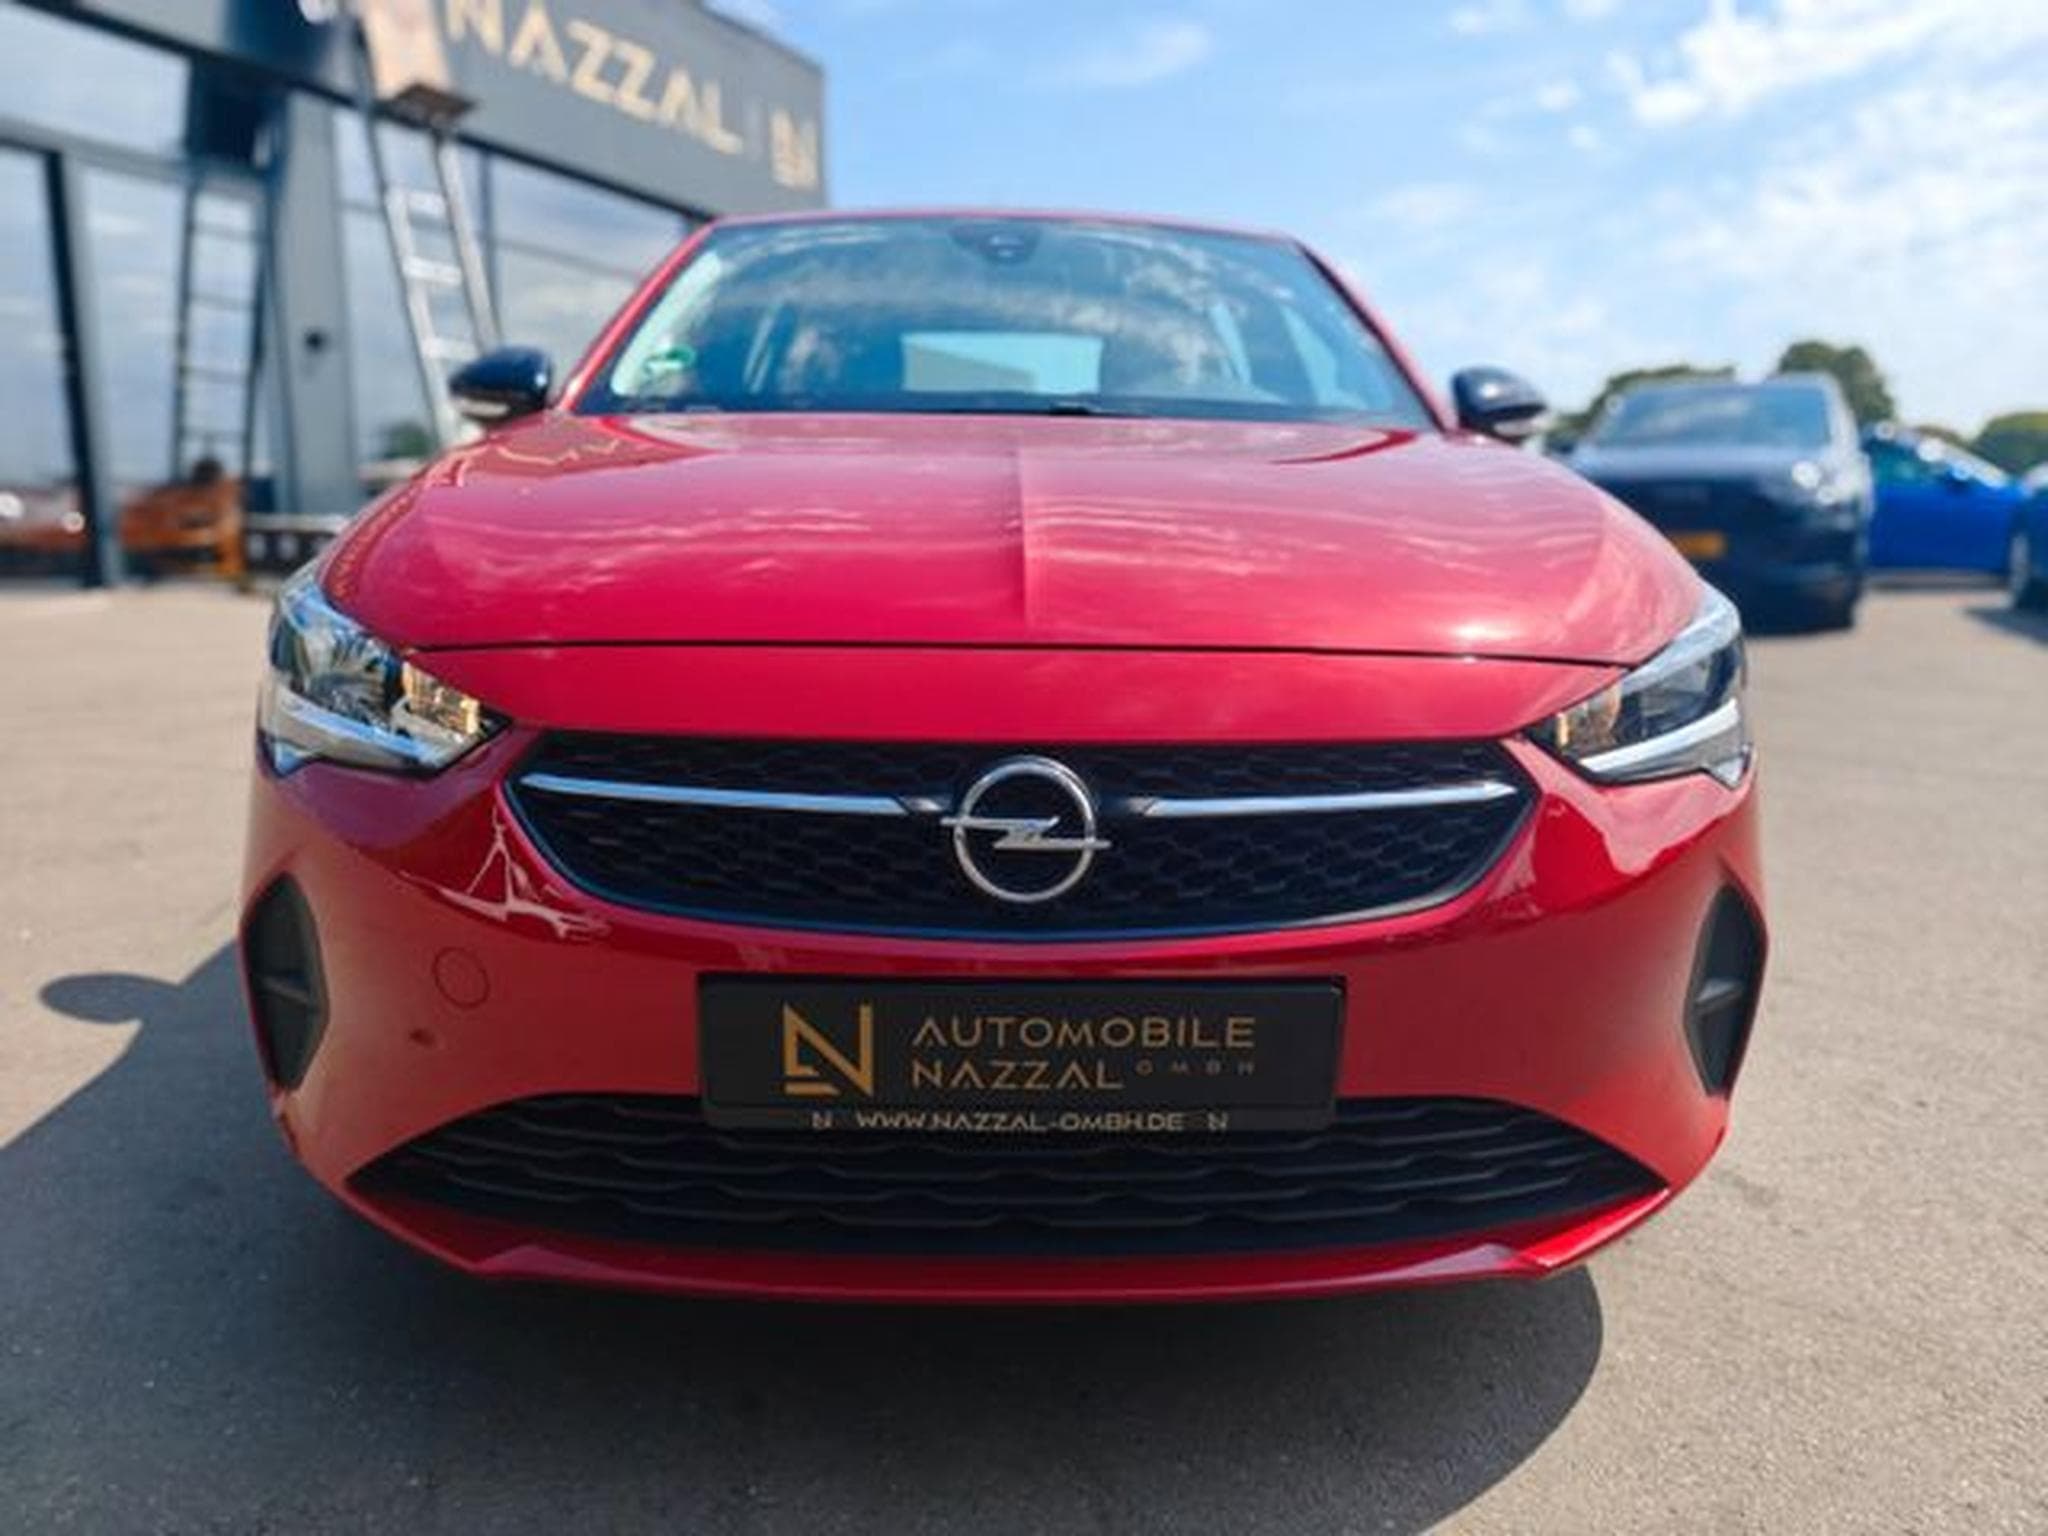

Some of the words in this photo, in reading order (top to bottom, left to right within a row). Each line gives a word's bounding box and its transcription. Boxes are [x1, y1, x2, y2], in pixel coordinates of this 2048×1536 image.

[444, 0, 743, 156] NAZZAL
[912, 1015, 1256, 1049] AUTOMOBILE
[911, 1059, 1123, 1090] NAZZAL
